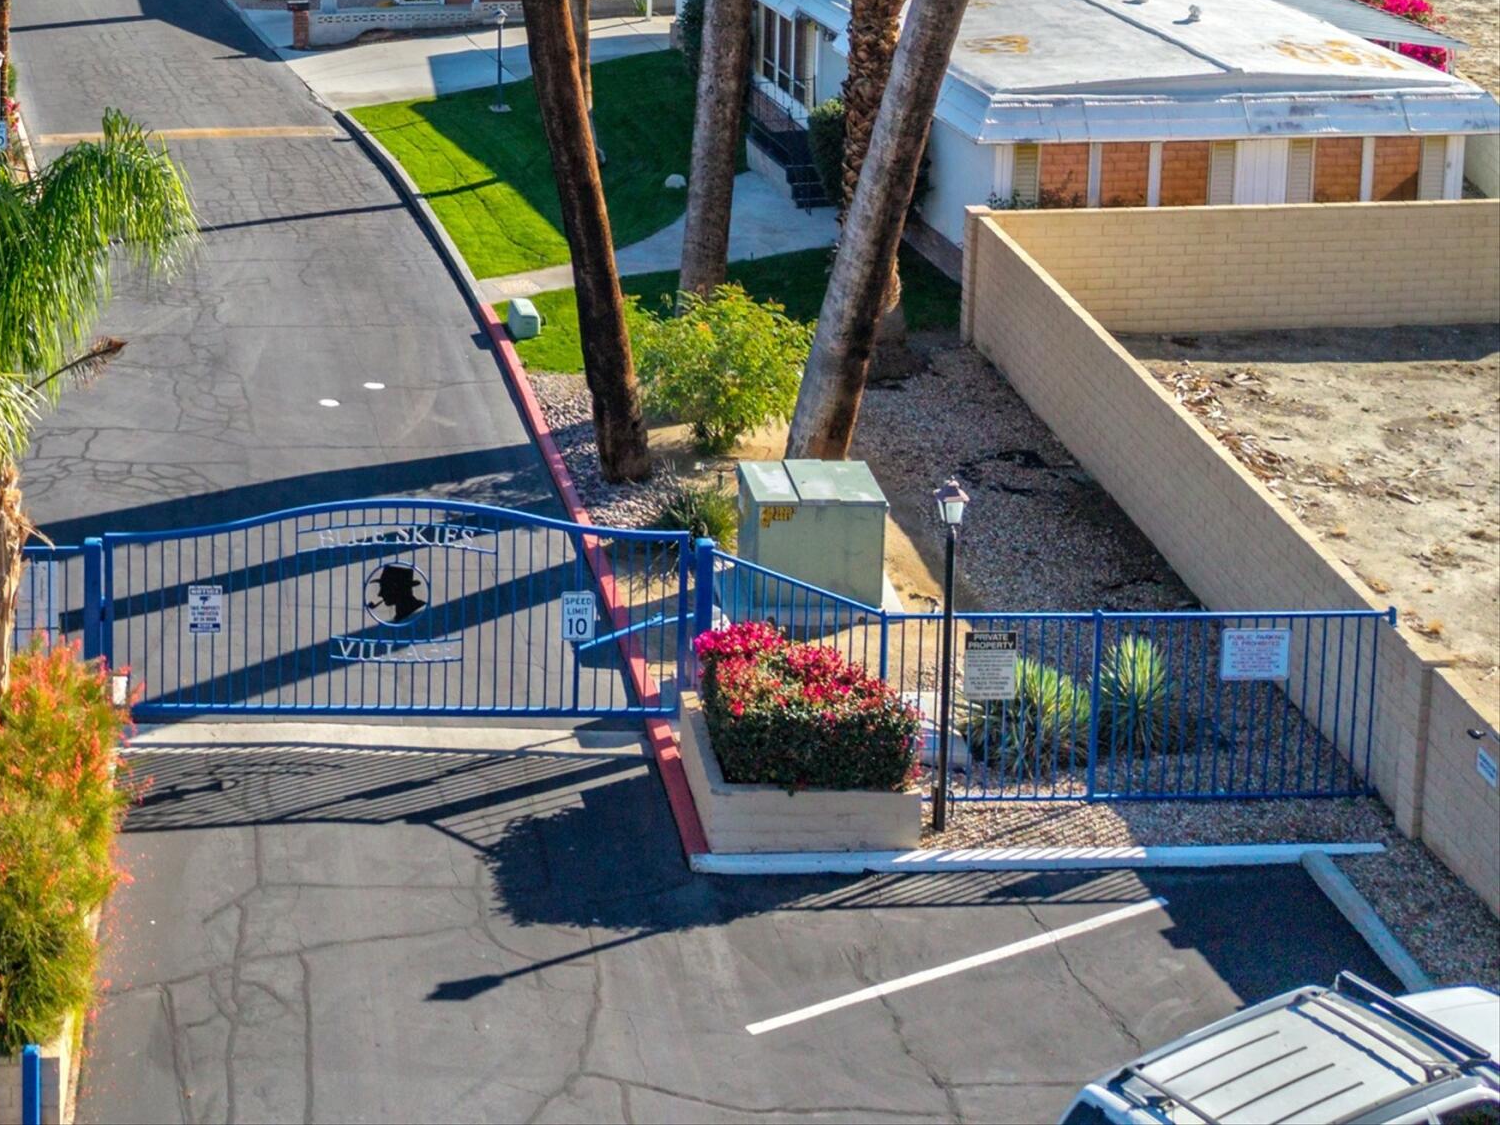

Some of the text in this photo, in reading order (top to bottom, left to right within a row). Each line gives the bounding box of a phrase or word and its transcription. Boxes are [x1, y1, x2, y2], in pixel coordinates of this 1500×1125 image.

[319, 526, 475, 549] BLUE SKIES
[564, 597, 592, 605] SPEED
[568, 618, 587, 635] 10
[338, 641, 456, 663] VILLAGE
[968, 641, 1014, 649] PROPERTY
